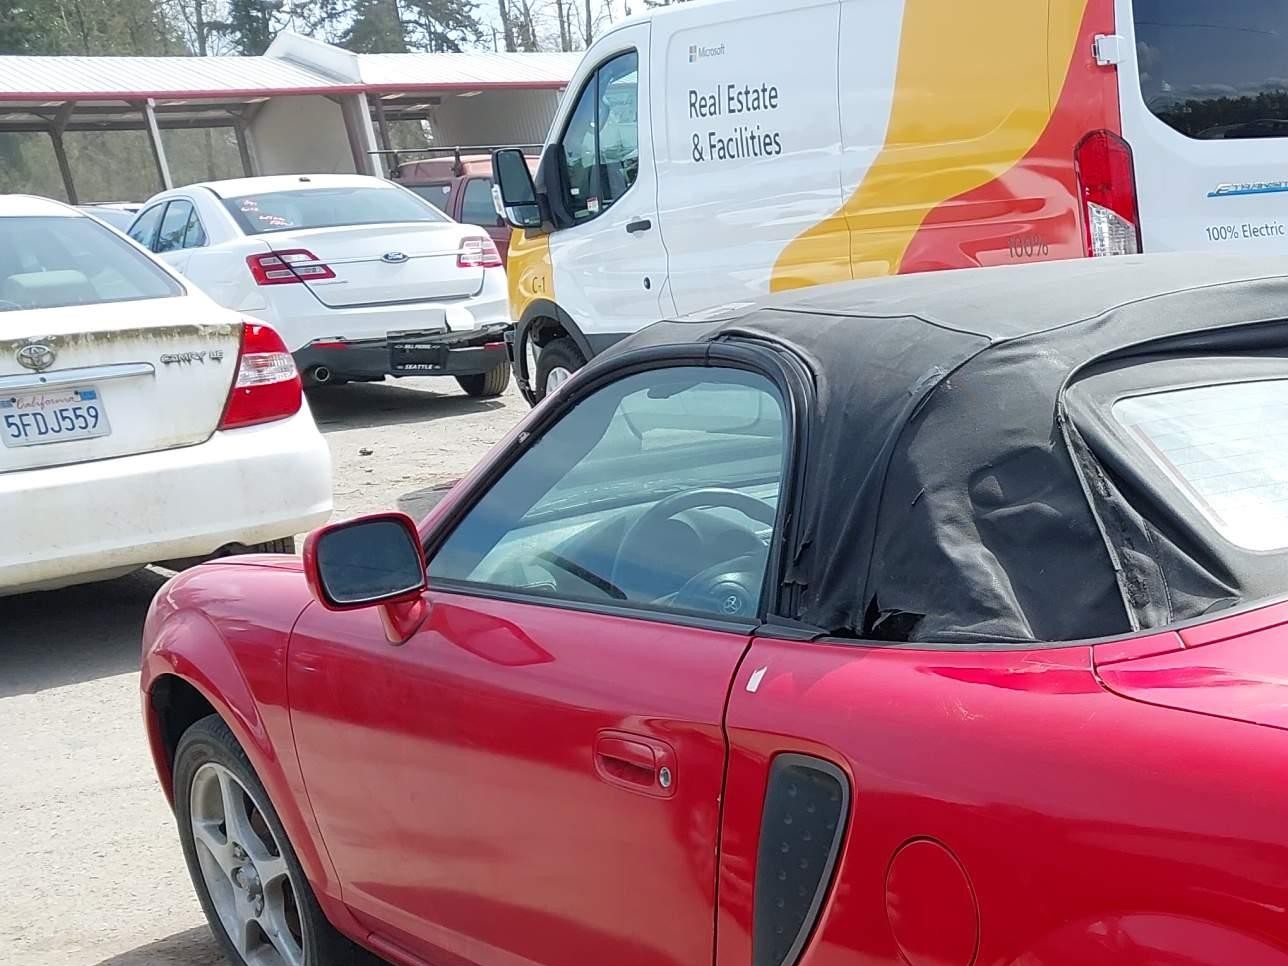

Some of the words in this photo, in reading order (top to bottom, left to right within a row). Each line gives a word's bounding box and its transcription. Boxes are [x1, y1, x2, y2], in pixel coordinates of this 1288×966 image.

[697, 44, 725, 58] Microsoft
[688, 84, 721, 119] Real
[728, 82, 778, 114] Estate
[692, 133, 704, 162] &
[709, 125, 782, 160] Facilities
[1206, 225, 1239, 241] 100%
[1242, 221, 1285, 238] Electric
[1008, 235, 1049, 258] 100%
[532, 276, 545, 294] C-1
[16, 394, 80, 411] California
[3, 406, 99, 439] 5FDJ559
